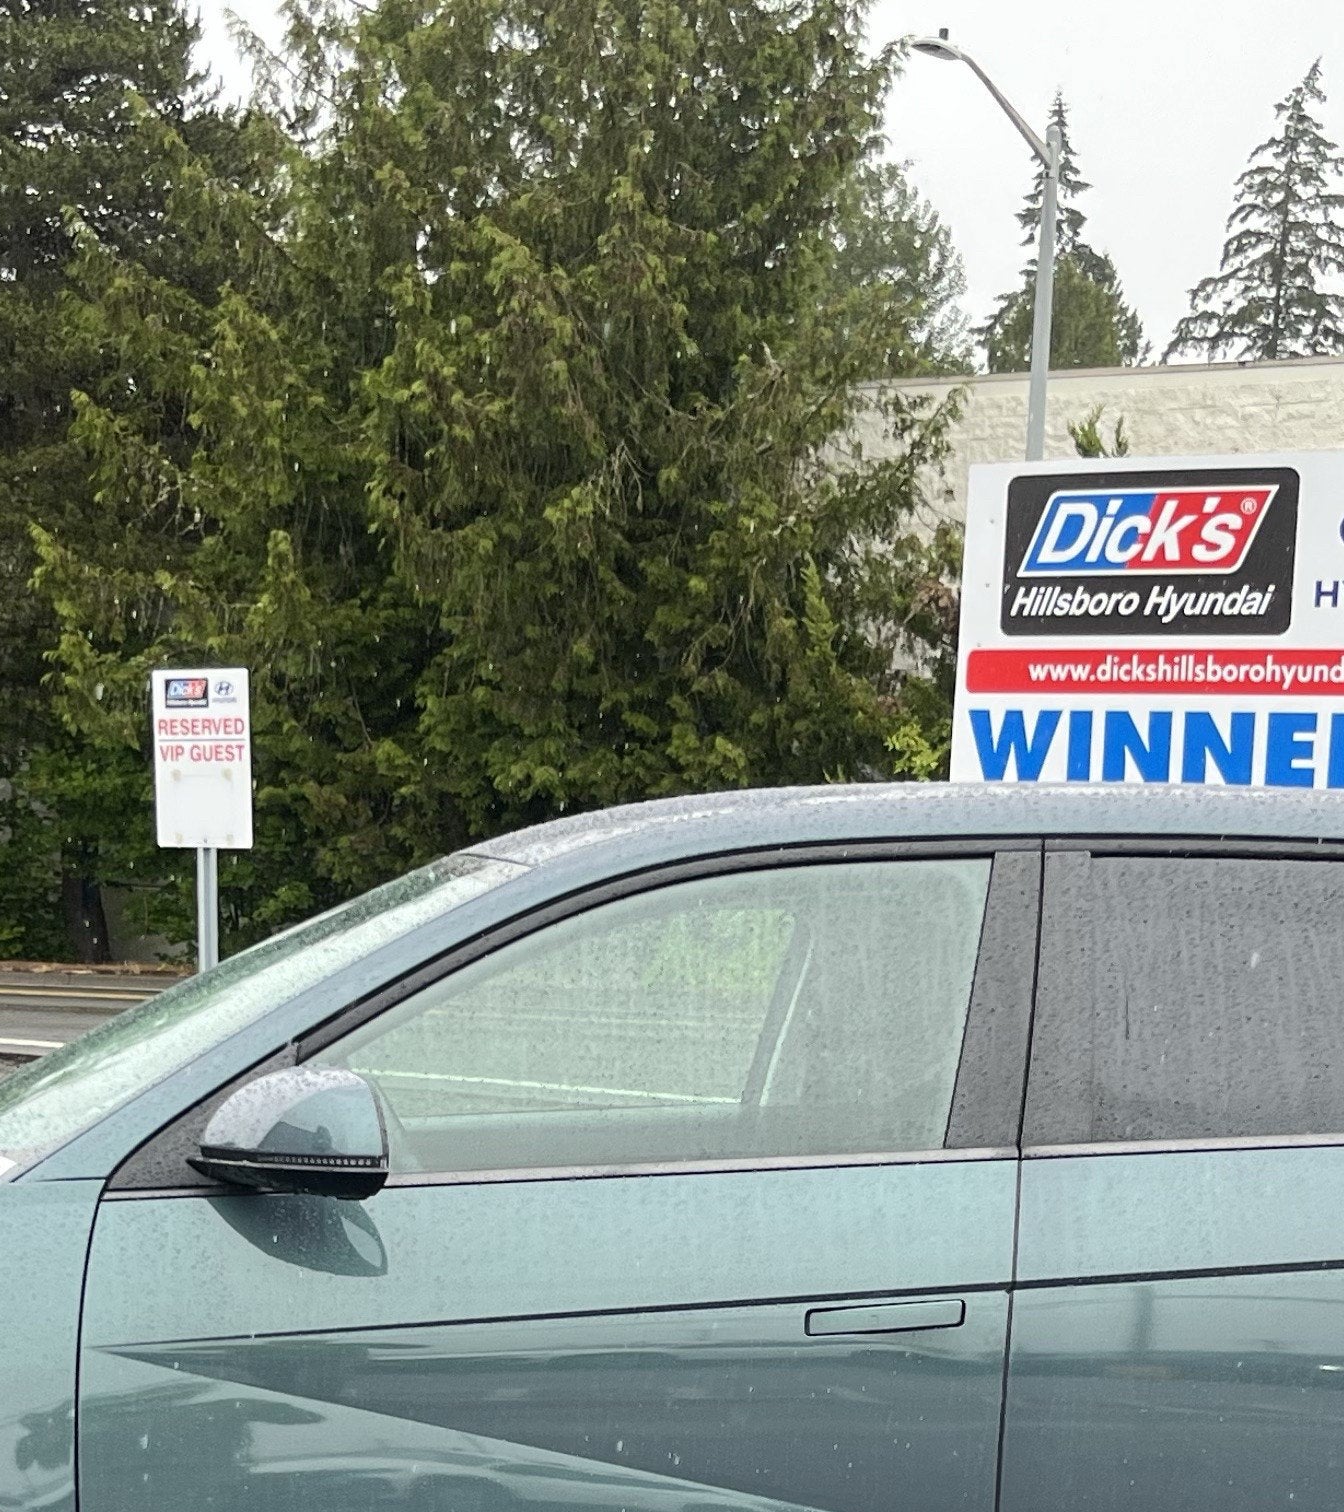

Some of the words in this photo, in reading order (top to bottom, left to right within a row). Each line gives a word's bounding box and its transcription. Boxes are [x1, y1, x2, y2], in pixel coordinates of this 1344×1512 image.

[1036, 497, 1244, 566] Dick's
[1009, 584, 1140, 618] Hillsboro
[1143, 584, 1275, 623] Hyundai
[157, 717, 245, 737] RESERVED
[159, 744, 185, 762] VIP
[190, 744, 245, 763] GUEST
